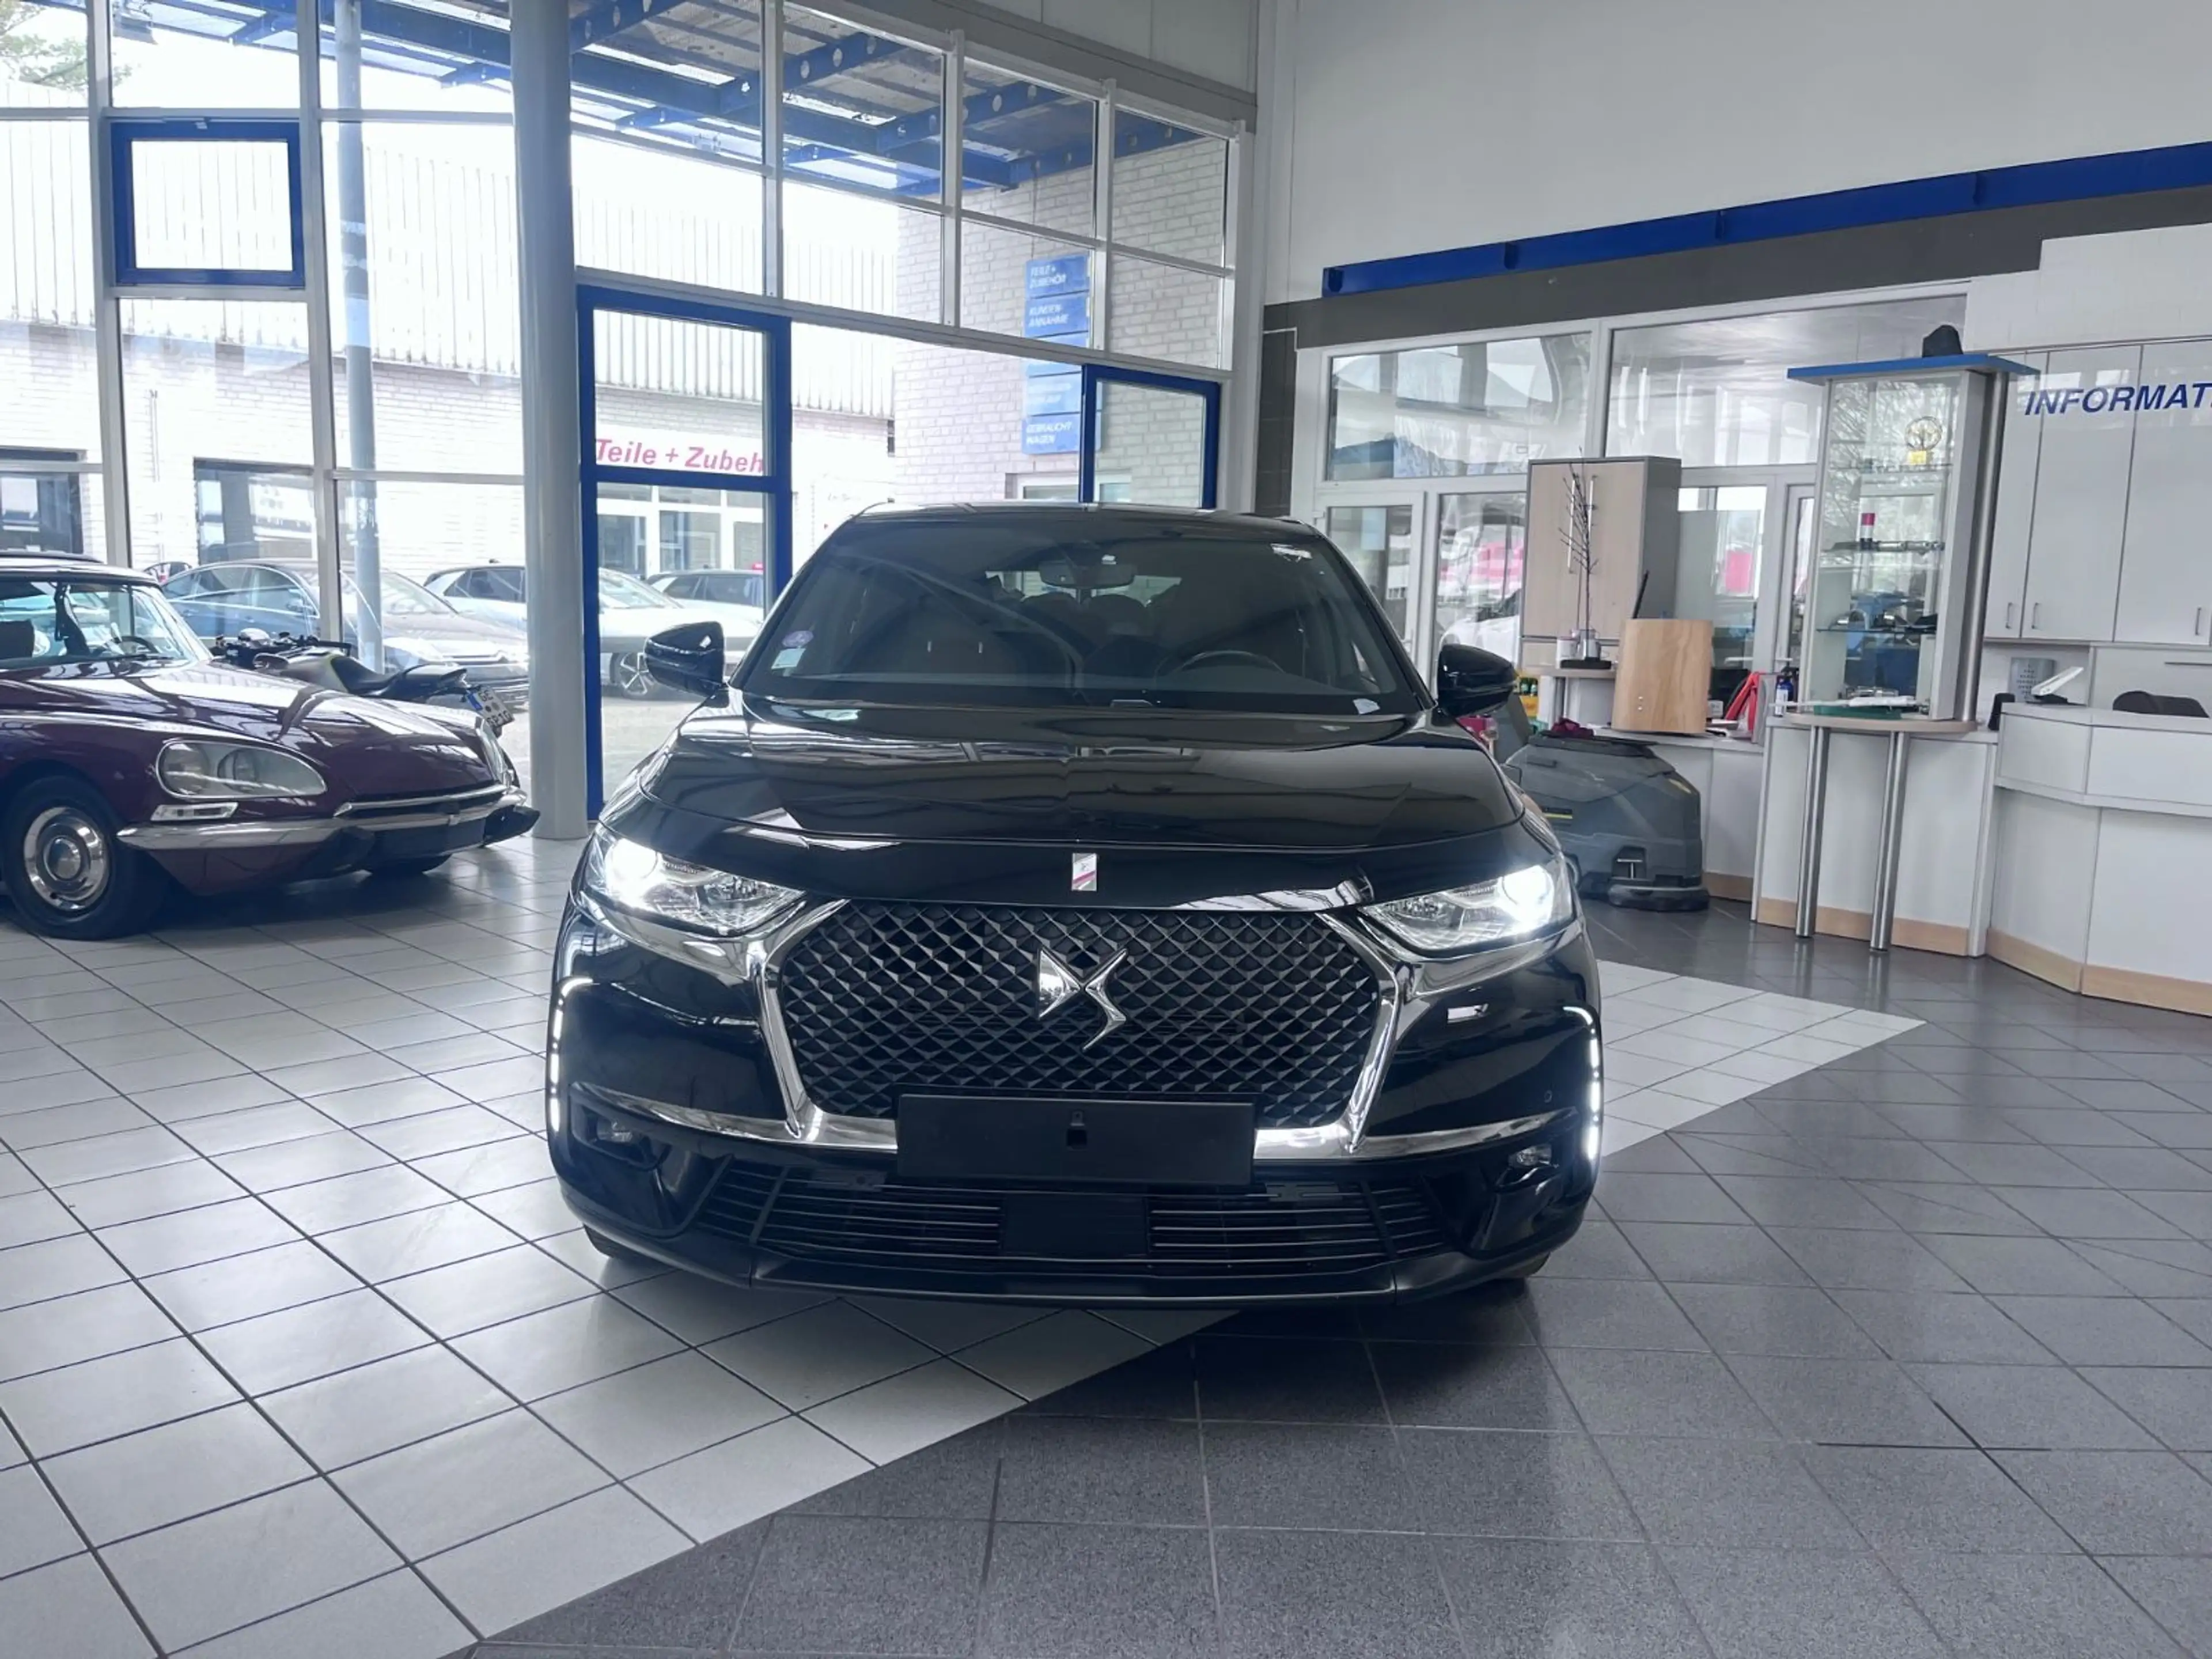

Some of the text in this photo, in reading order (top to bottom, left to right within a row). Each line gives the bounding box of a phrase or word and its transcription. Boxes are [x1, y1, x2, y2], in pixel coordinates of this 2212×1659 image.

[1028, 314, 1069, 327] ANNAHME
[2025, 382, 2212, 415] INFORMAT
[1026, 434, 1055, 445] WAGEN
[596, 438, 764, 474] Teile + Zubeh
